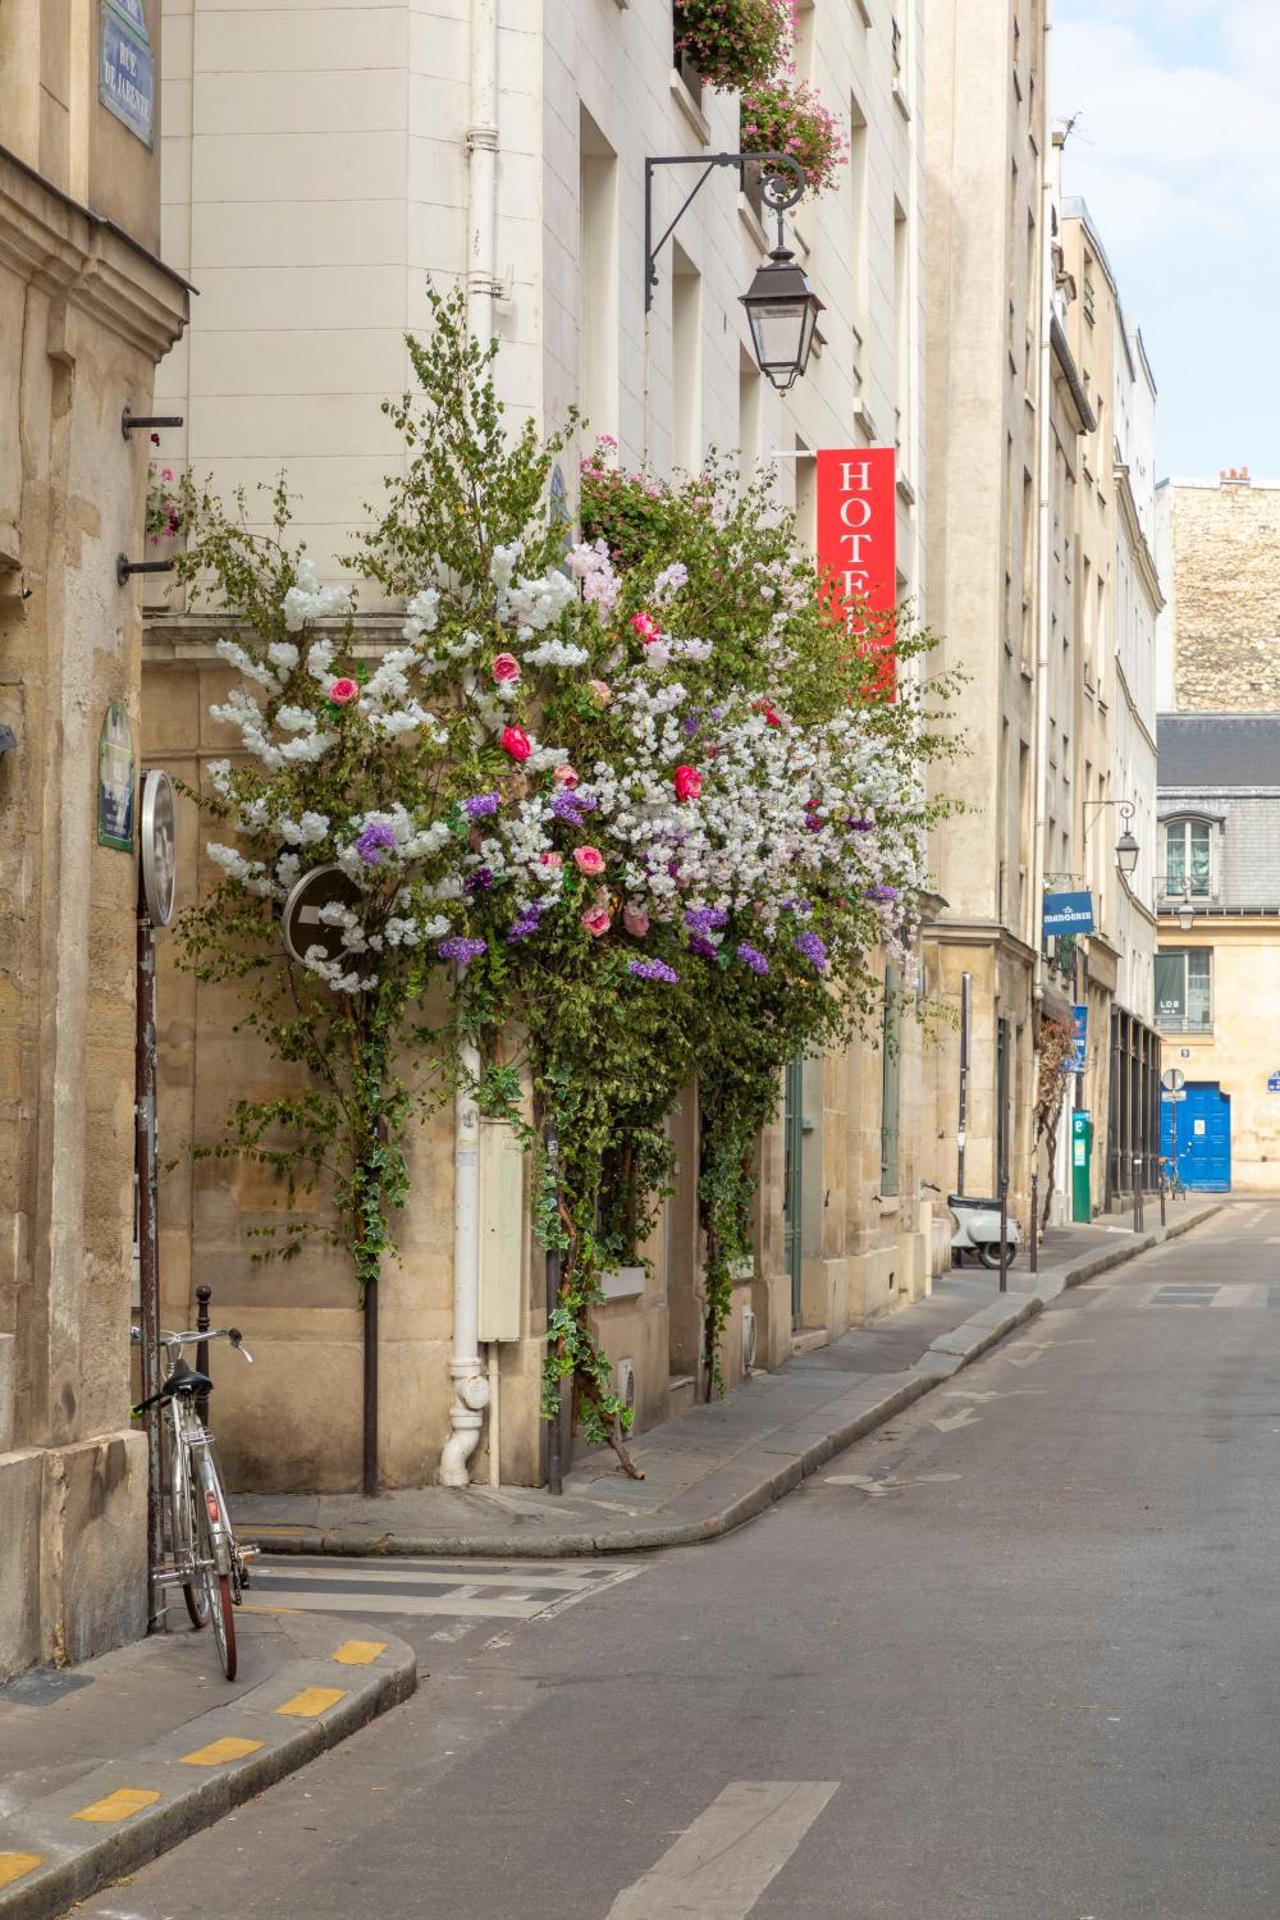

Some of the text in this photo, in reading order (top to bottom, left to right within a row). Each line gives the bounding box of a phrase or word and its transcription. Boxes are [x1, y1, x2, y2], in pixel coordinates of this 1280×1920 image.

[104, 61, 116, 90] DE
[119, 41, 137, 77] RUE
[839, 462, 872, 635] HOTEL
